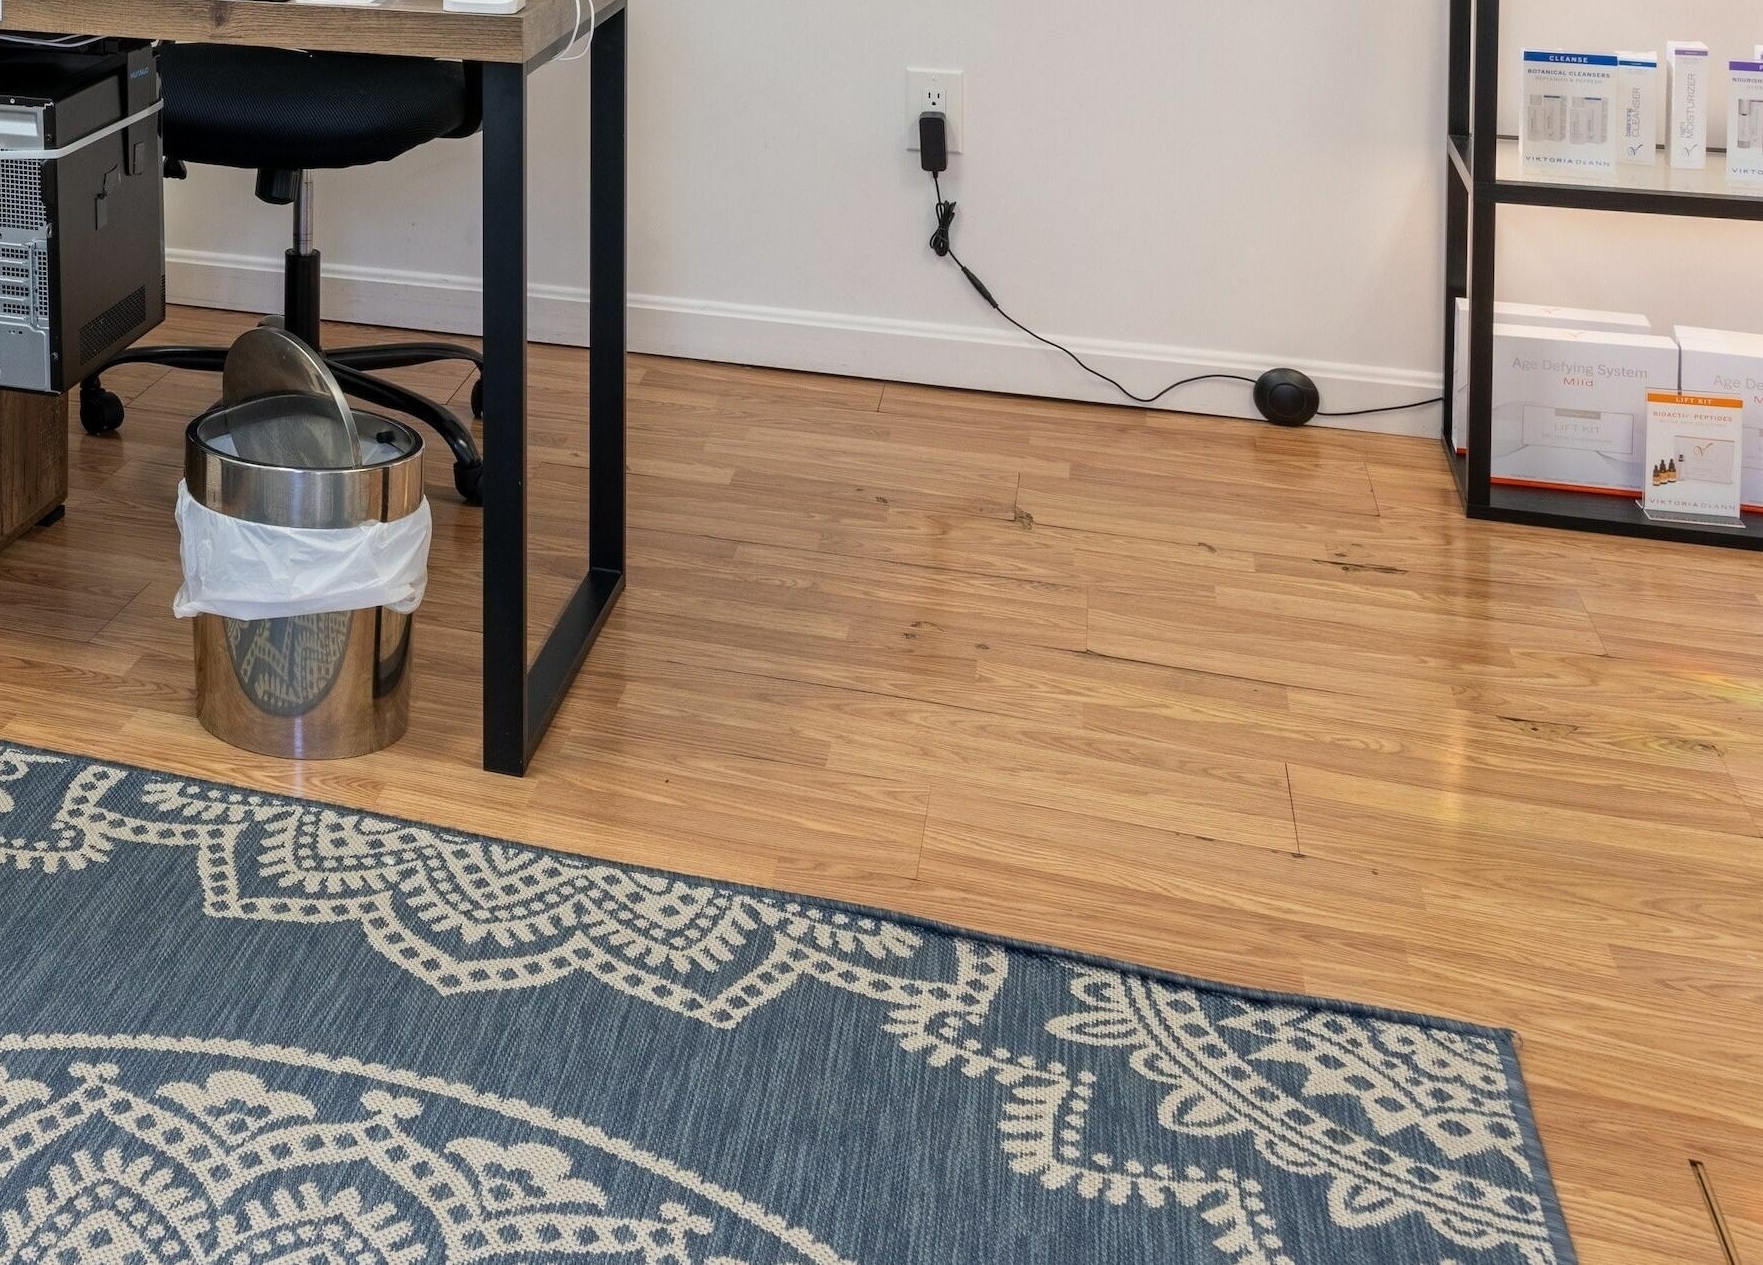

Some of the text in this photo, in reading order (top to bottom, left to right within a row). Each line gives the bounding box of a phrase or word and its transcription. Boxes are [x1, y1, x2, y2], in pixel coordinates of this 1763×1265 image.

[1549, 55, 1589, 64] CLEANSE
[1527, 68, 1611, 79] BOTANICAL CLEANSERS
[1686, 72, 1696, 139] MOISTURIZER
[1512, 357, 1648, 379] Age Defying System
[1563, 377, 1594, 387] Mild
[1713, 375, 1741, 390] Age
